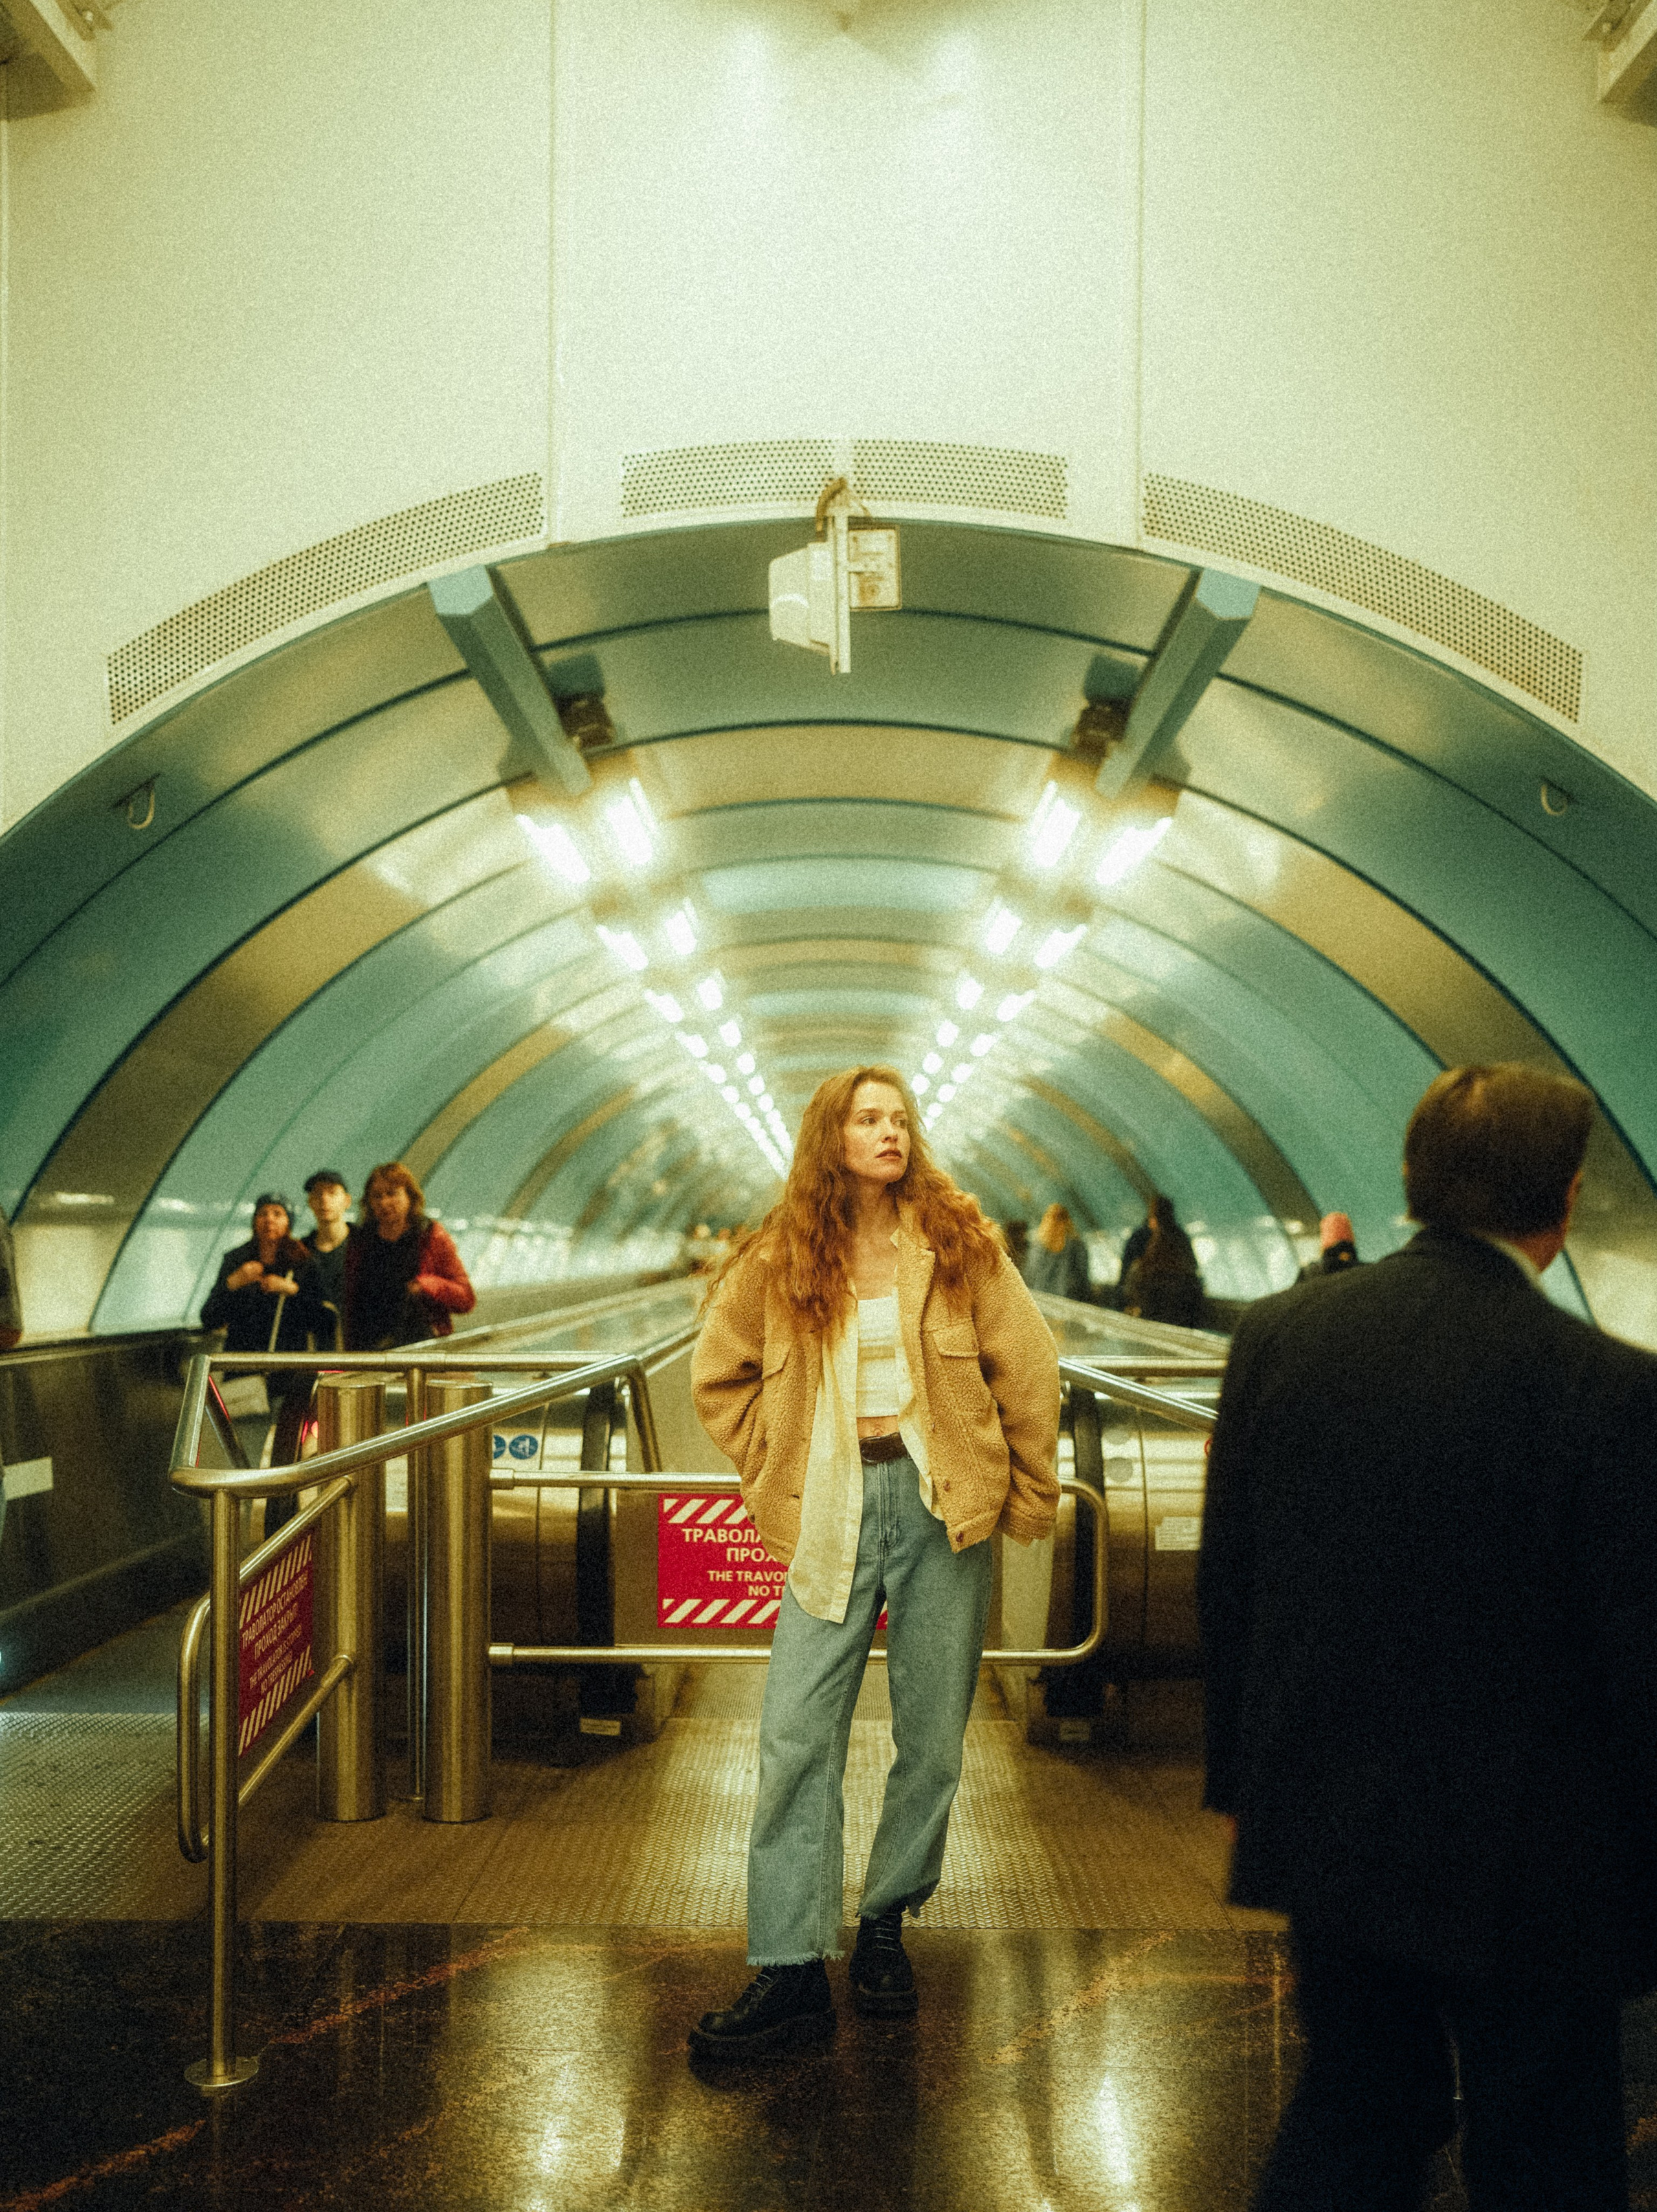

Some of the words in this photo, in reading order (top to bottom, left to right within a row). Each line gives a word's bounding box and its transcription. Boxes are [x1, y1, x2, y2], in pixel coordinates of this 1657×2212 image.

[707, 1570, 733, 1581] THE
[748, 1585, 770, 1596] NO
[242, 1602, 276, 1649] ТРАВОЛАТОР
[255, 1624, 277, 1660] ПРОХОД
